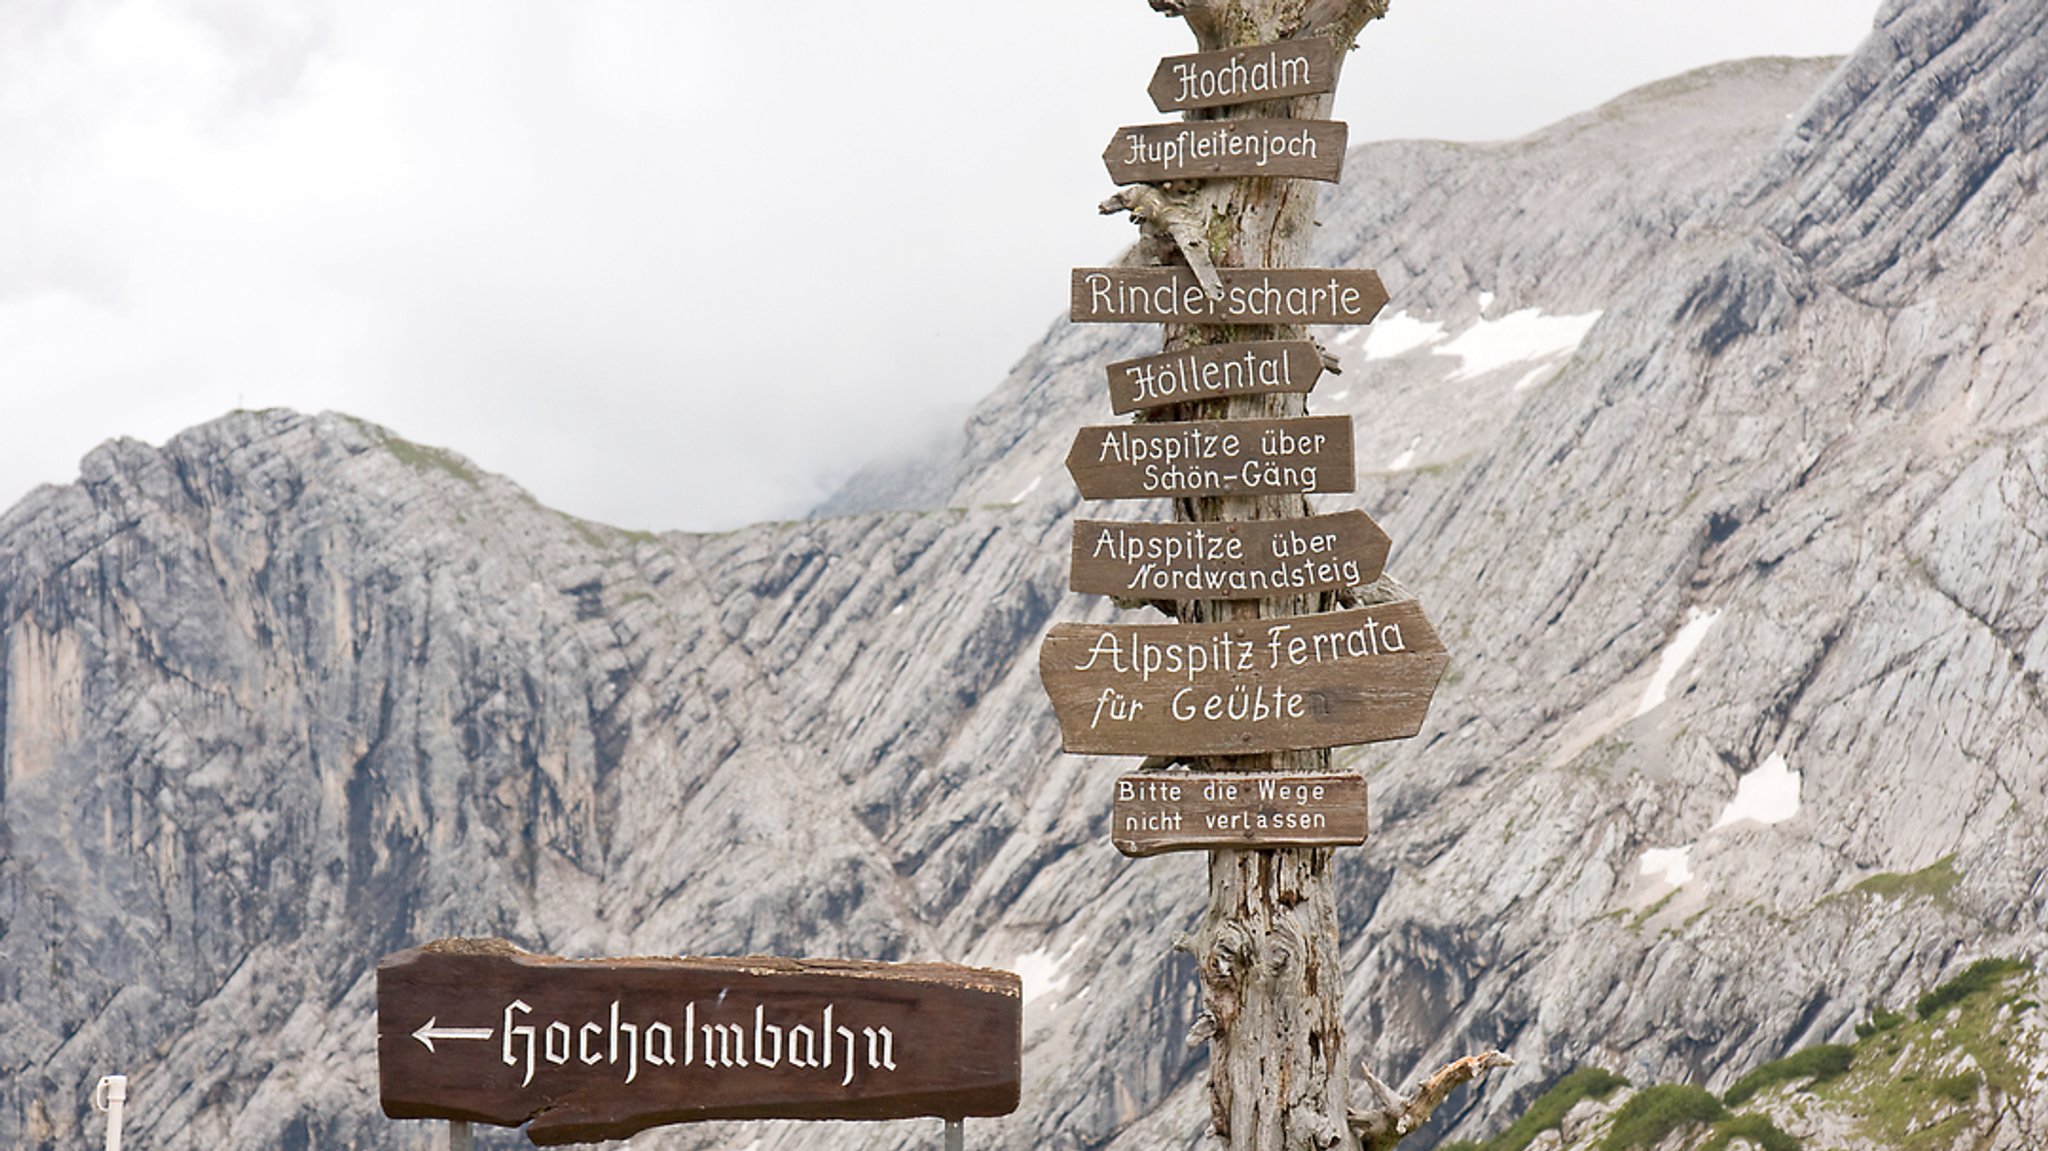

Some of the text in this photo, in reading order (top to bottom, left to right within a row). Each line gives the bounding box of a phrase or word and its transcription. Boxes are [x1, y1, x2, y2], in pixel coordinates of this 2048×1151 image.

[1173, 52, 1310, 102] Hochalm
[1124, 130, 1317, 169] Hupfleitenjoch
[1126, 350, 1291, 401] Höllental
[1100, 429, 1326, 465] Alpspitze über
[1143, 460, 1317, 493] Schön-Gäng
[1093, 528, 1337, 566] Alpspitze über
[1127, 558, 1361, 590] Nordwandsteig
[1074, 616, 1406, 681] Alpspitz Ferrata
[1090, 687, 1143, 729] für
[1118, 779, 1325, 805] Bitte die Wege
[1125, 810, 1326, 832] nicht verlassen
[502, 999, 897, 1087] Hochalmbahn
